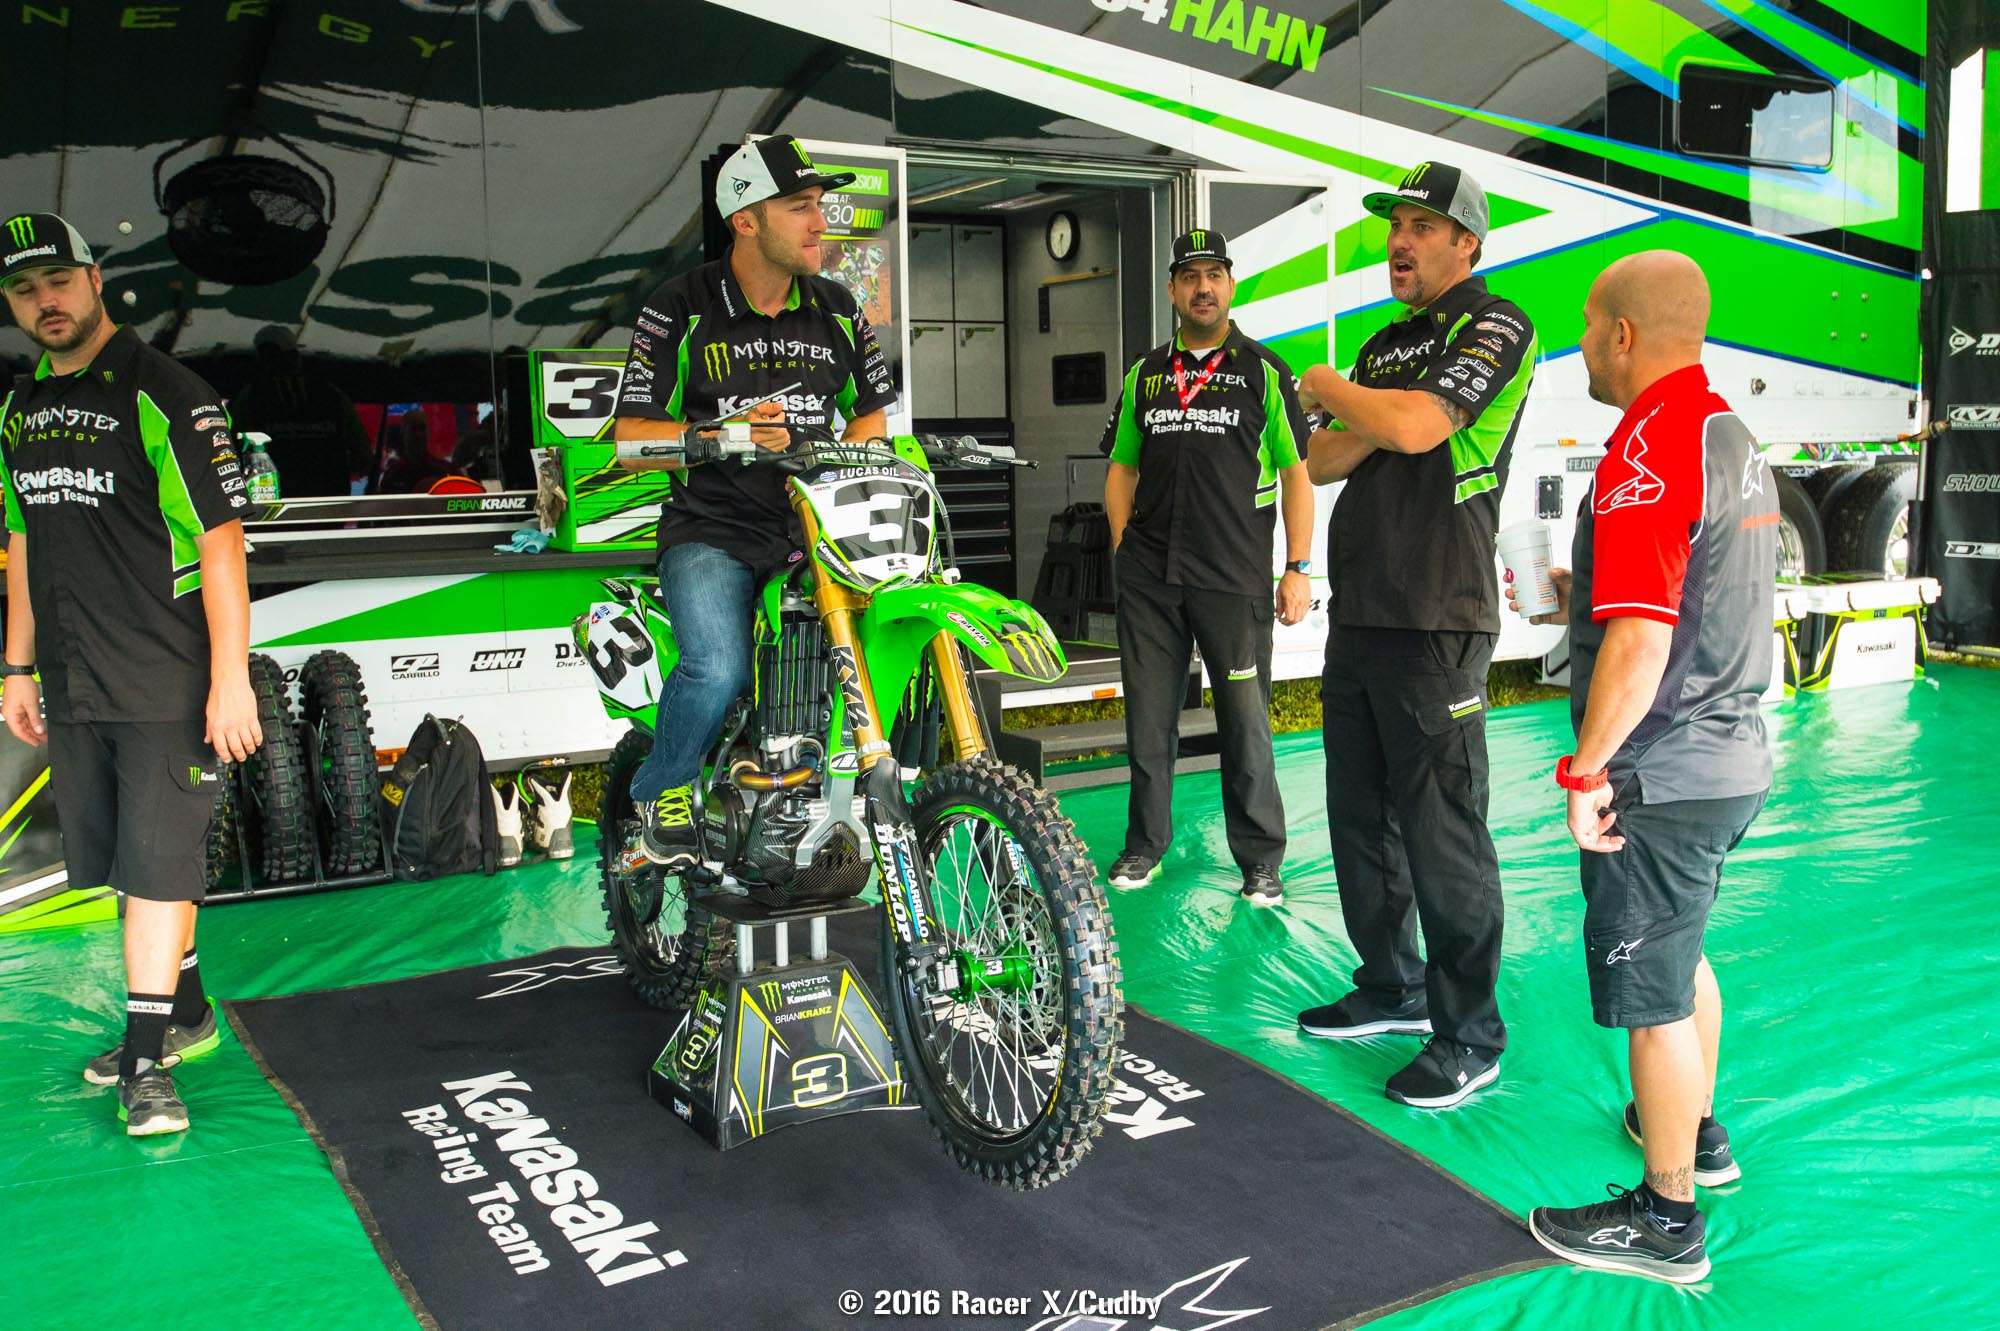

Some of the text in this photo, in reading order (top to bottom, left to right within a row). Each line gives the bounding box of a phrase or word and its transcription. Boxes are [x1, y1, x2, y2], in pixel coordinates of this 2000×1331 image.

[1169, 0, 1327, 73] HAHN
[4, 244, 57, 266] Kawasaki
[720, 279, 735, 318] Kawasaki
[642, 306, 673, 322] UNLOP
[733, 338, 836, 364] MONSTER
[1165, 370, 1248, 388] MNTER
[547, 368, 620, 418] 3
[1459, 387, 1480, 402] UNI
[24, 404, 120, 432] MONSTER
[787, 413, 825, 425] Team
[1144, 407, 1240, 427] Kawasaki
[1152, 421, 1225, 434] Racing Team
[839, 467, 900, 480] LUCAS OIL
[61, 488, 99, 508] Team
[833, 479, 930, 563] 3
[817, 542, 851, 576] Kawasaki
[588, 616, 653, 690] 3
[1857, 641, 1896, 653] Kawasaki
[470, 648, 526, 672] UNI
[392, 671, 440, 680] CARRILLO
[874, 823, 912, 942] DUNLOP
[906, 868, 929, 938] CARRILLO
[781, 975, 830, 990] MONSTER
[786, 989, 832, 1005] Kawasaki
[681, 1034, 709, 1070] 3
[791, 1052, 848, 1108] 3
[401, 1103, 551, 1275] Racing Team
[441, 1071, 689, 1287] Kawasaki
